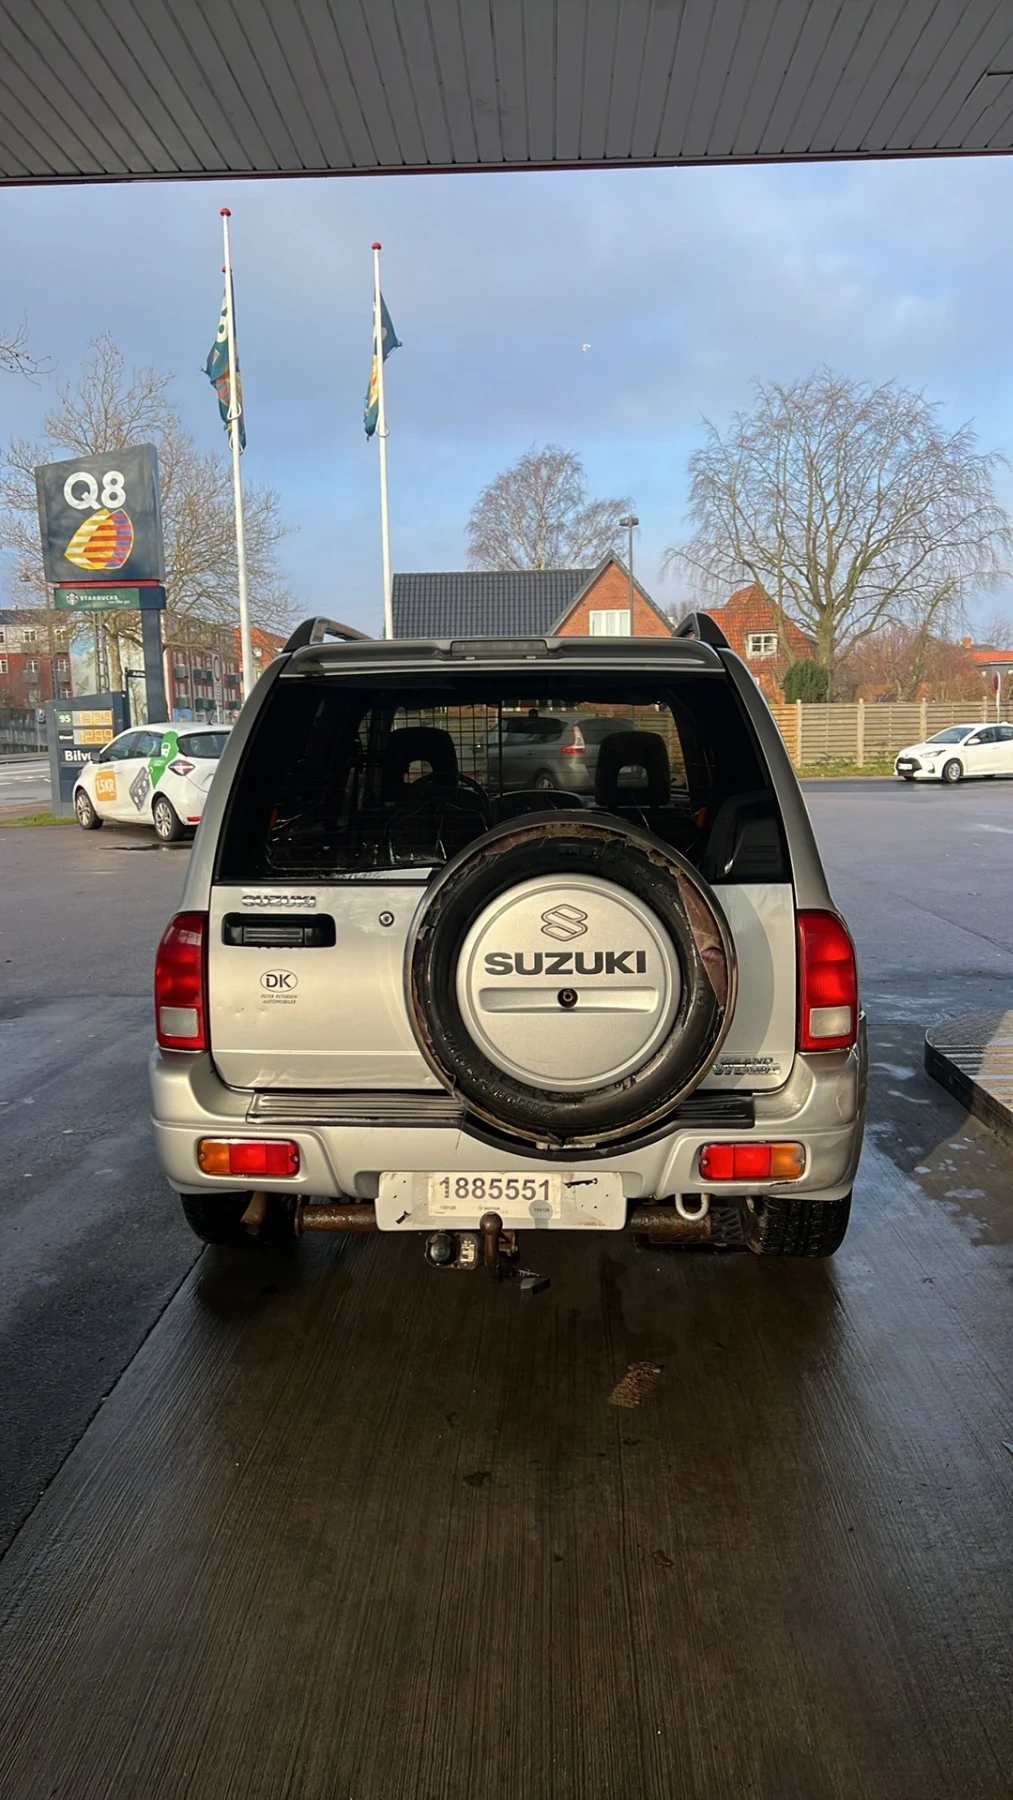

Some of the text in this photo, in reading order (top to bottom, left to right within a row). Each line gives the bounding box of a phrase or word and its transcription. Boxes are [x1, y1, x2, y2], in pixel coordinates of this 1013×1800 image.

[63, 470, 126, 510] Q8
[59, 714, 71, 723] 95
[241, 894, 316, 908] SUZUKI
[484, 950, 647, 976] SUZUKI
[266, 973, 292, 988] DK
[439, 1176, 549, 1201] 1885551
